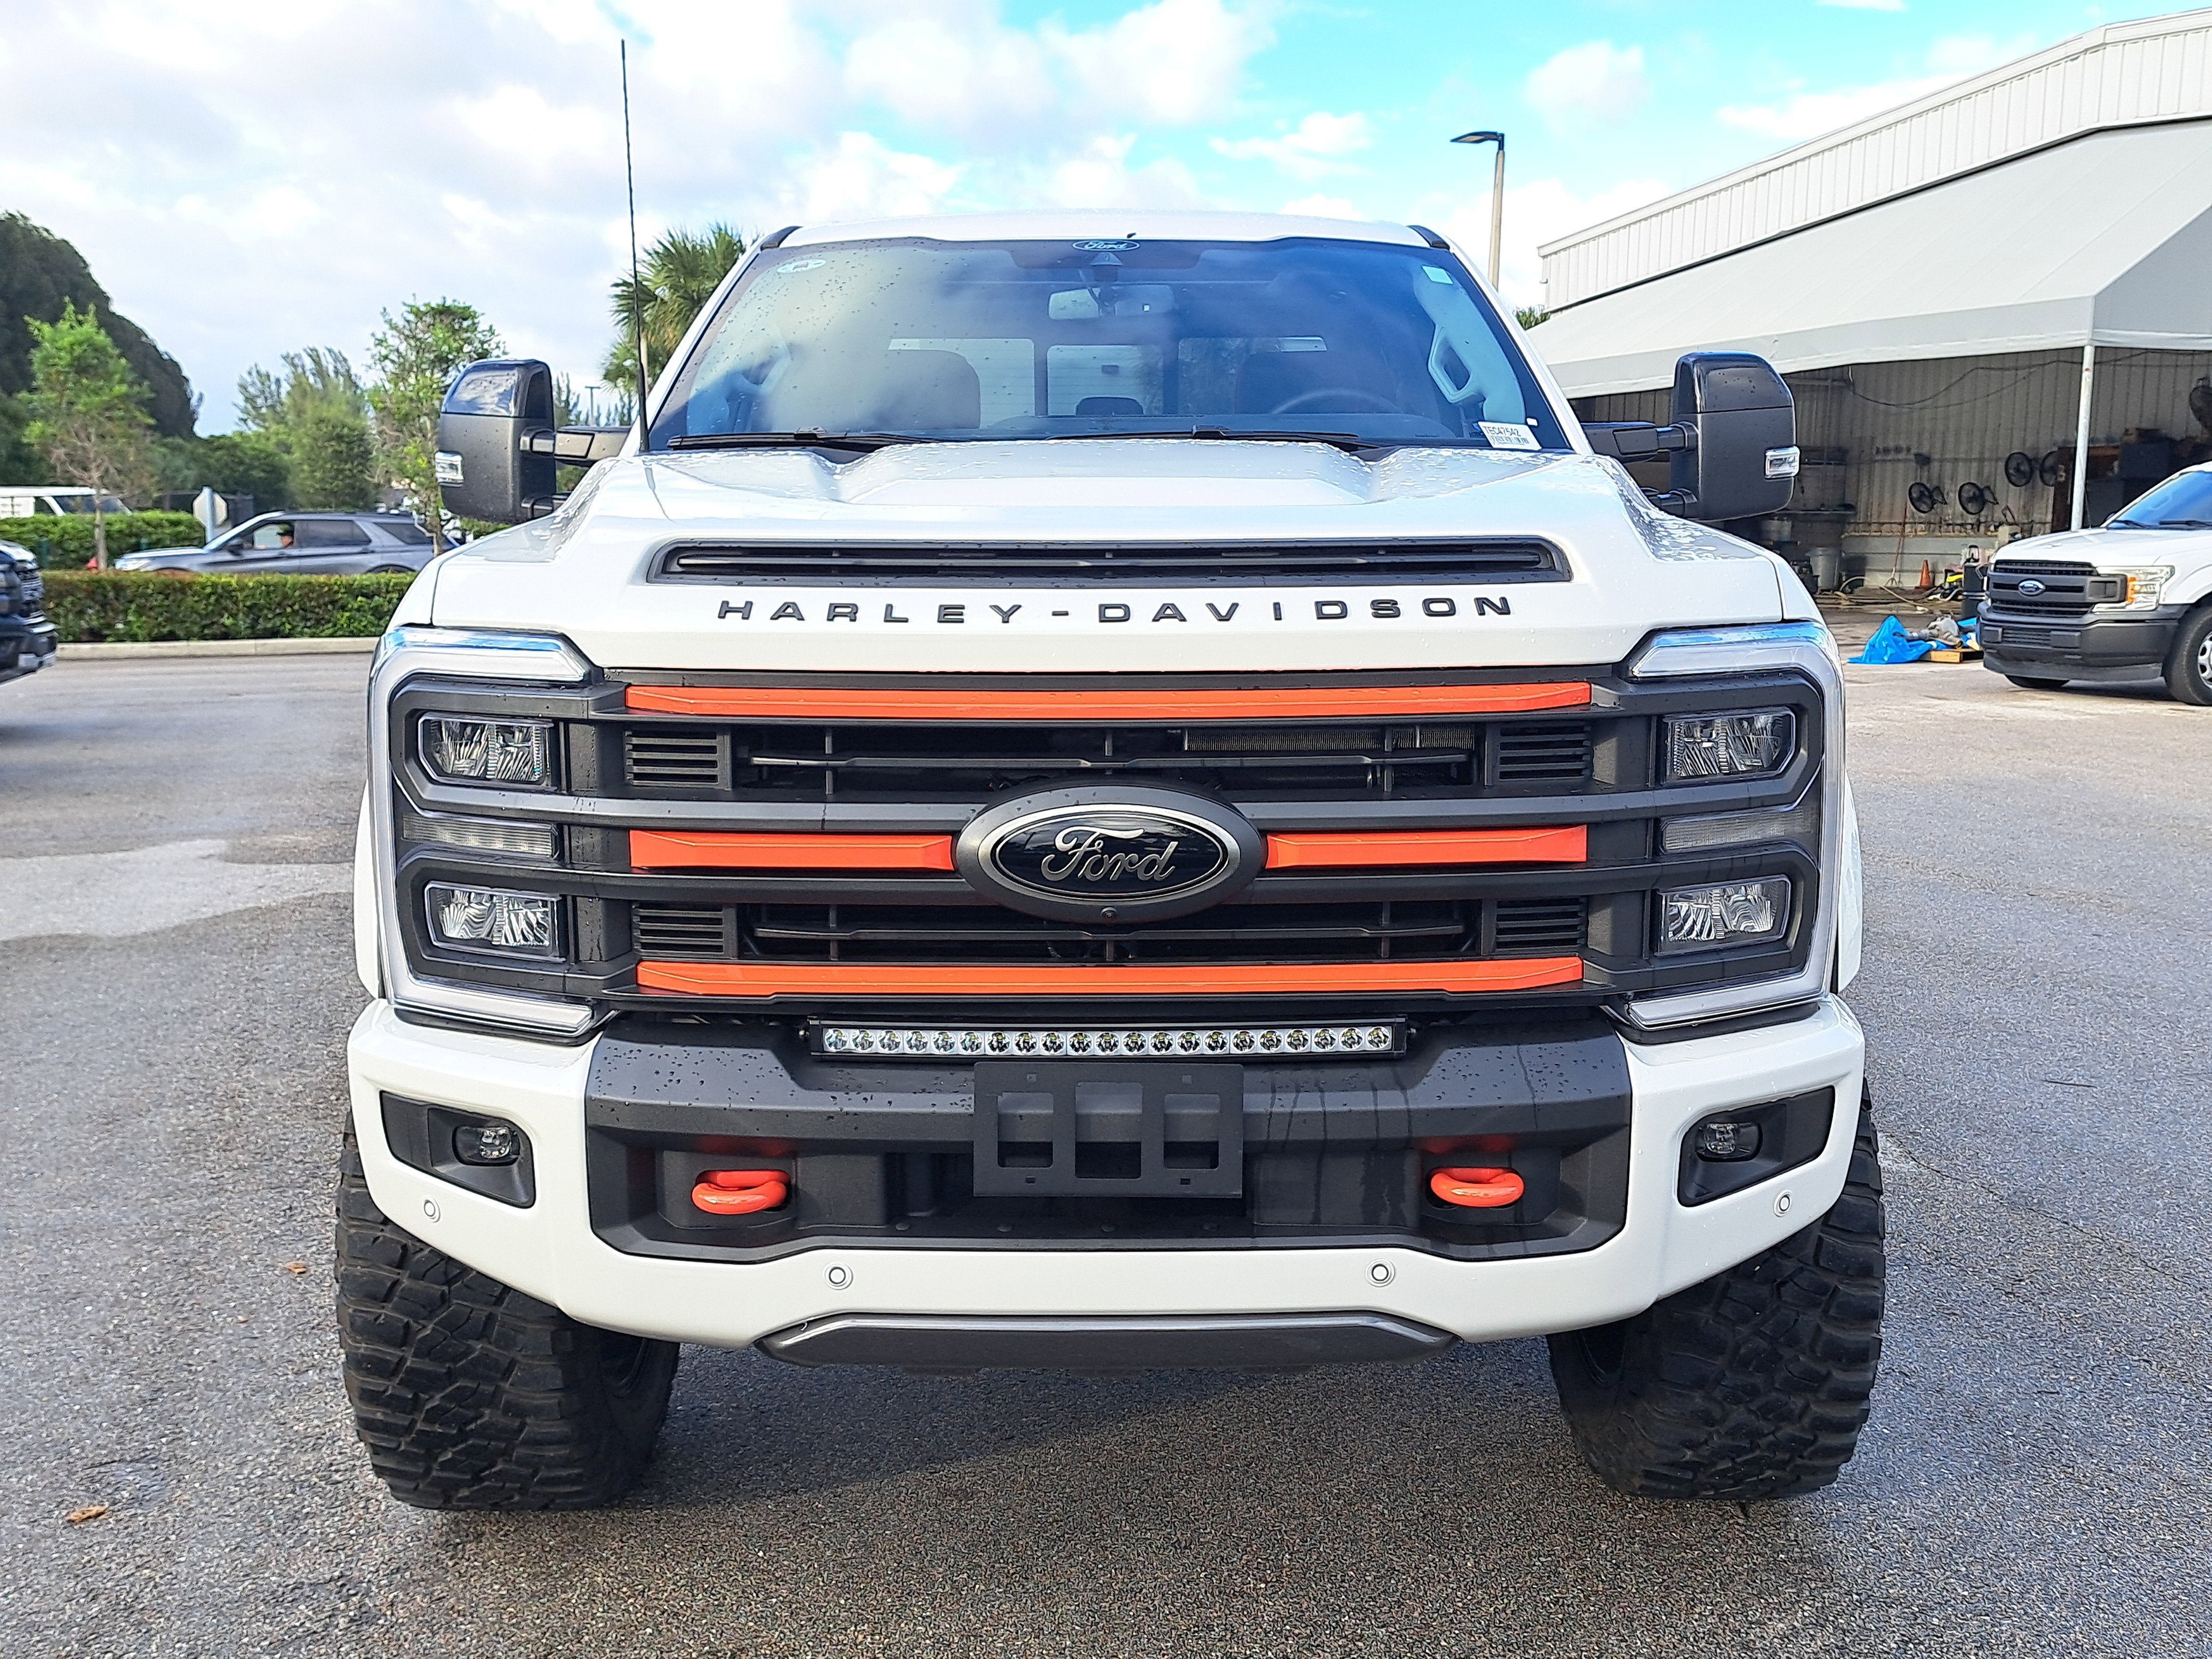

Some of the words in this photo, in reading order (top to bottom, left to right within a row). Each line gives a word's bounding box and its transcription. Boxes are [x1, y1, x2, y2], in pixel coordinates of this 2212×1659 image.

[1084, 240, 1128, 249] Ford
[717, 596, 1512, 624] HARLEY-DAVIDSON
[1041, 826, 1179, 881] Ford
